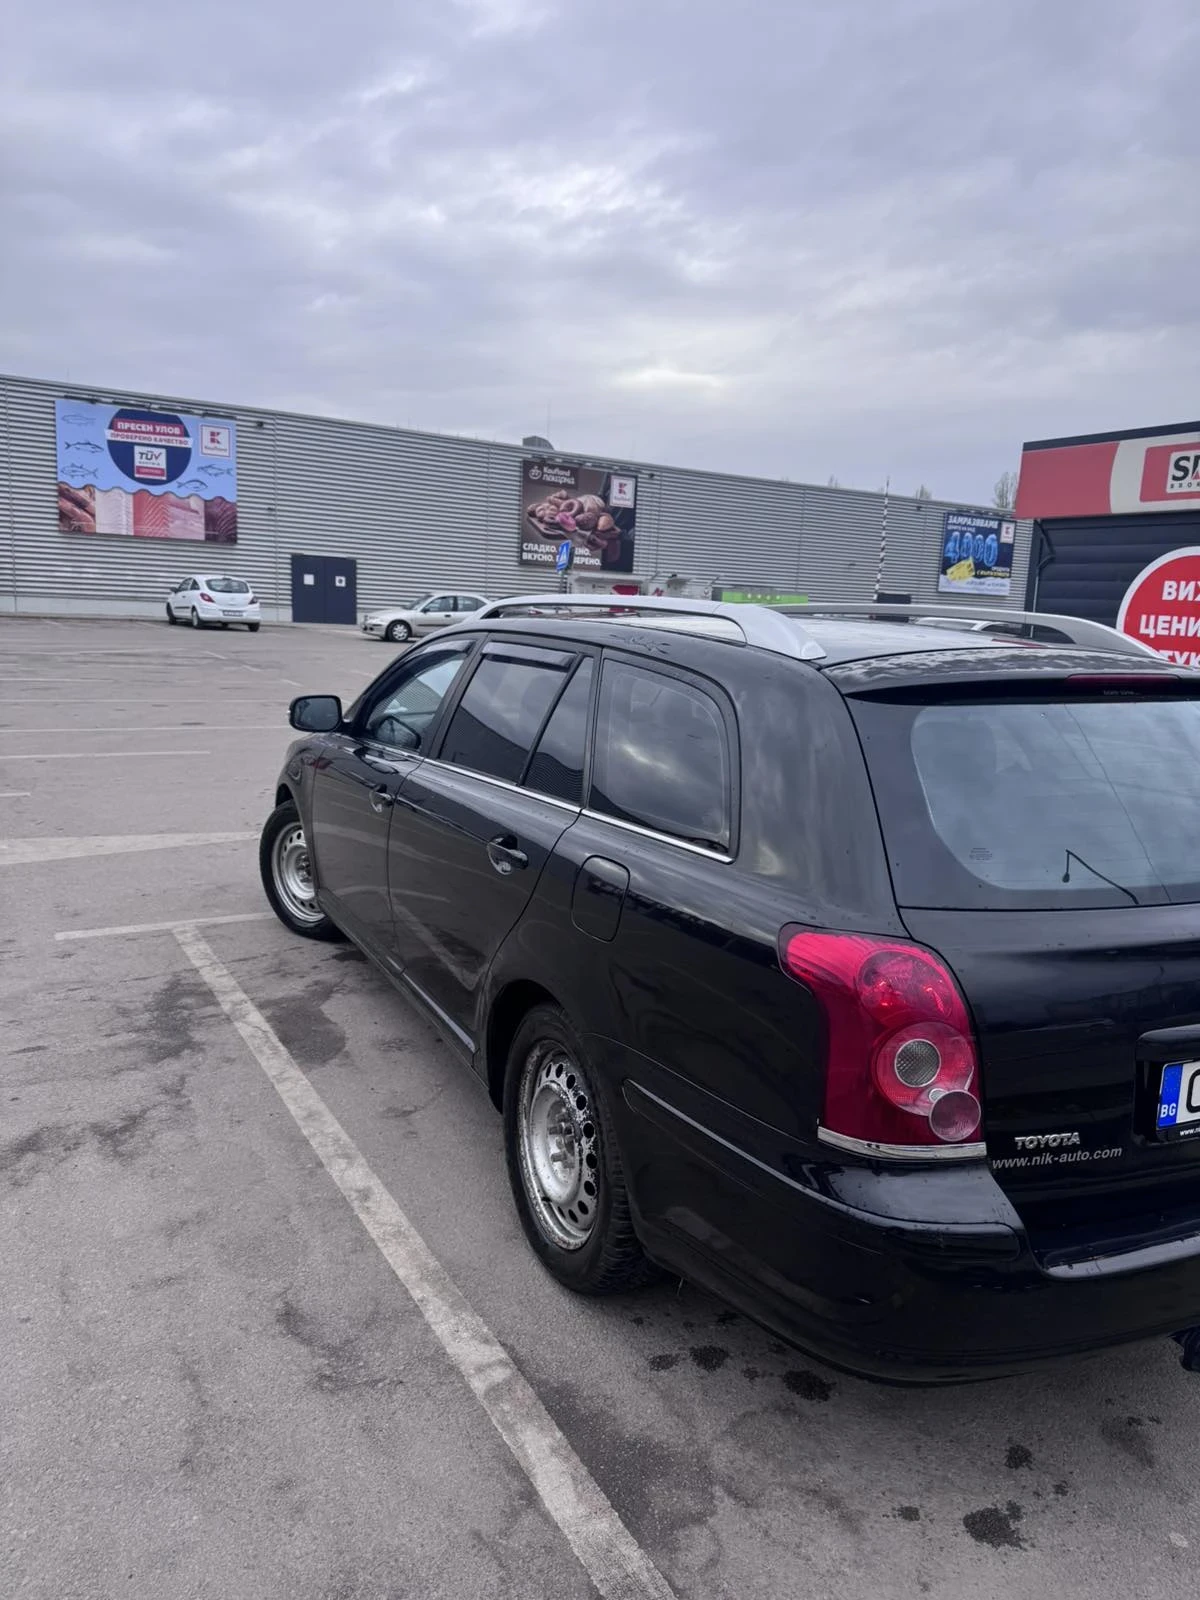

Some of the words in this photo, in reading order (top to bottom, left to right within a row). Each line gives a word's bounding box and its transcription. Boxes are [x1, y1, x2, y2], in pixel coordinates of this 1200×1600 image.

[117, 421, 153, 433] ПРЕСЕН
[155, 424, 181, 435] УЛОВ
[138, 449, 163, 461] TÜV
[522, 542, 557, 553] СЛАДКО.
[944, 531, 998, 567] 4000
[522, 552, 554, 562] ВКУСНО.
[1162, 580, 1200, 601] ВИ
[1160, 1103, 1177, 1118] BG
[1014, 1132, 1081, 1150] TOYOTA
[992, 1147, 1123, 1169] www.nik-auto.com
